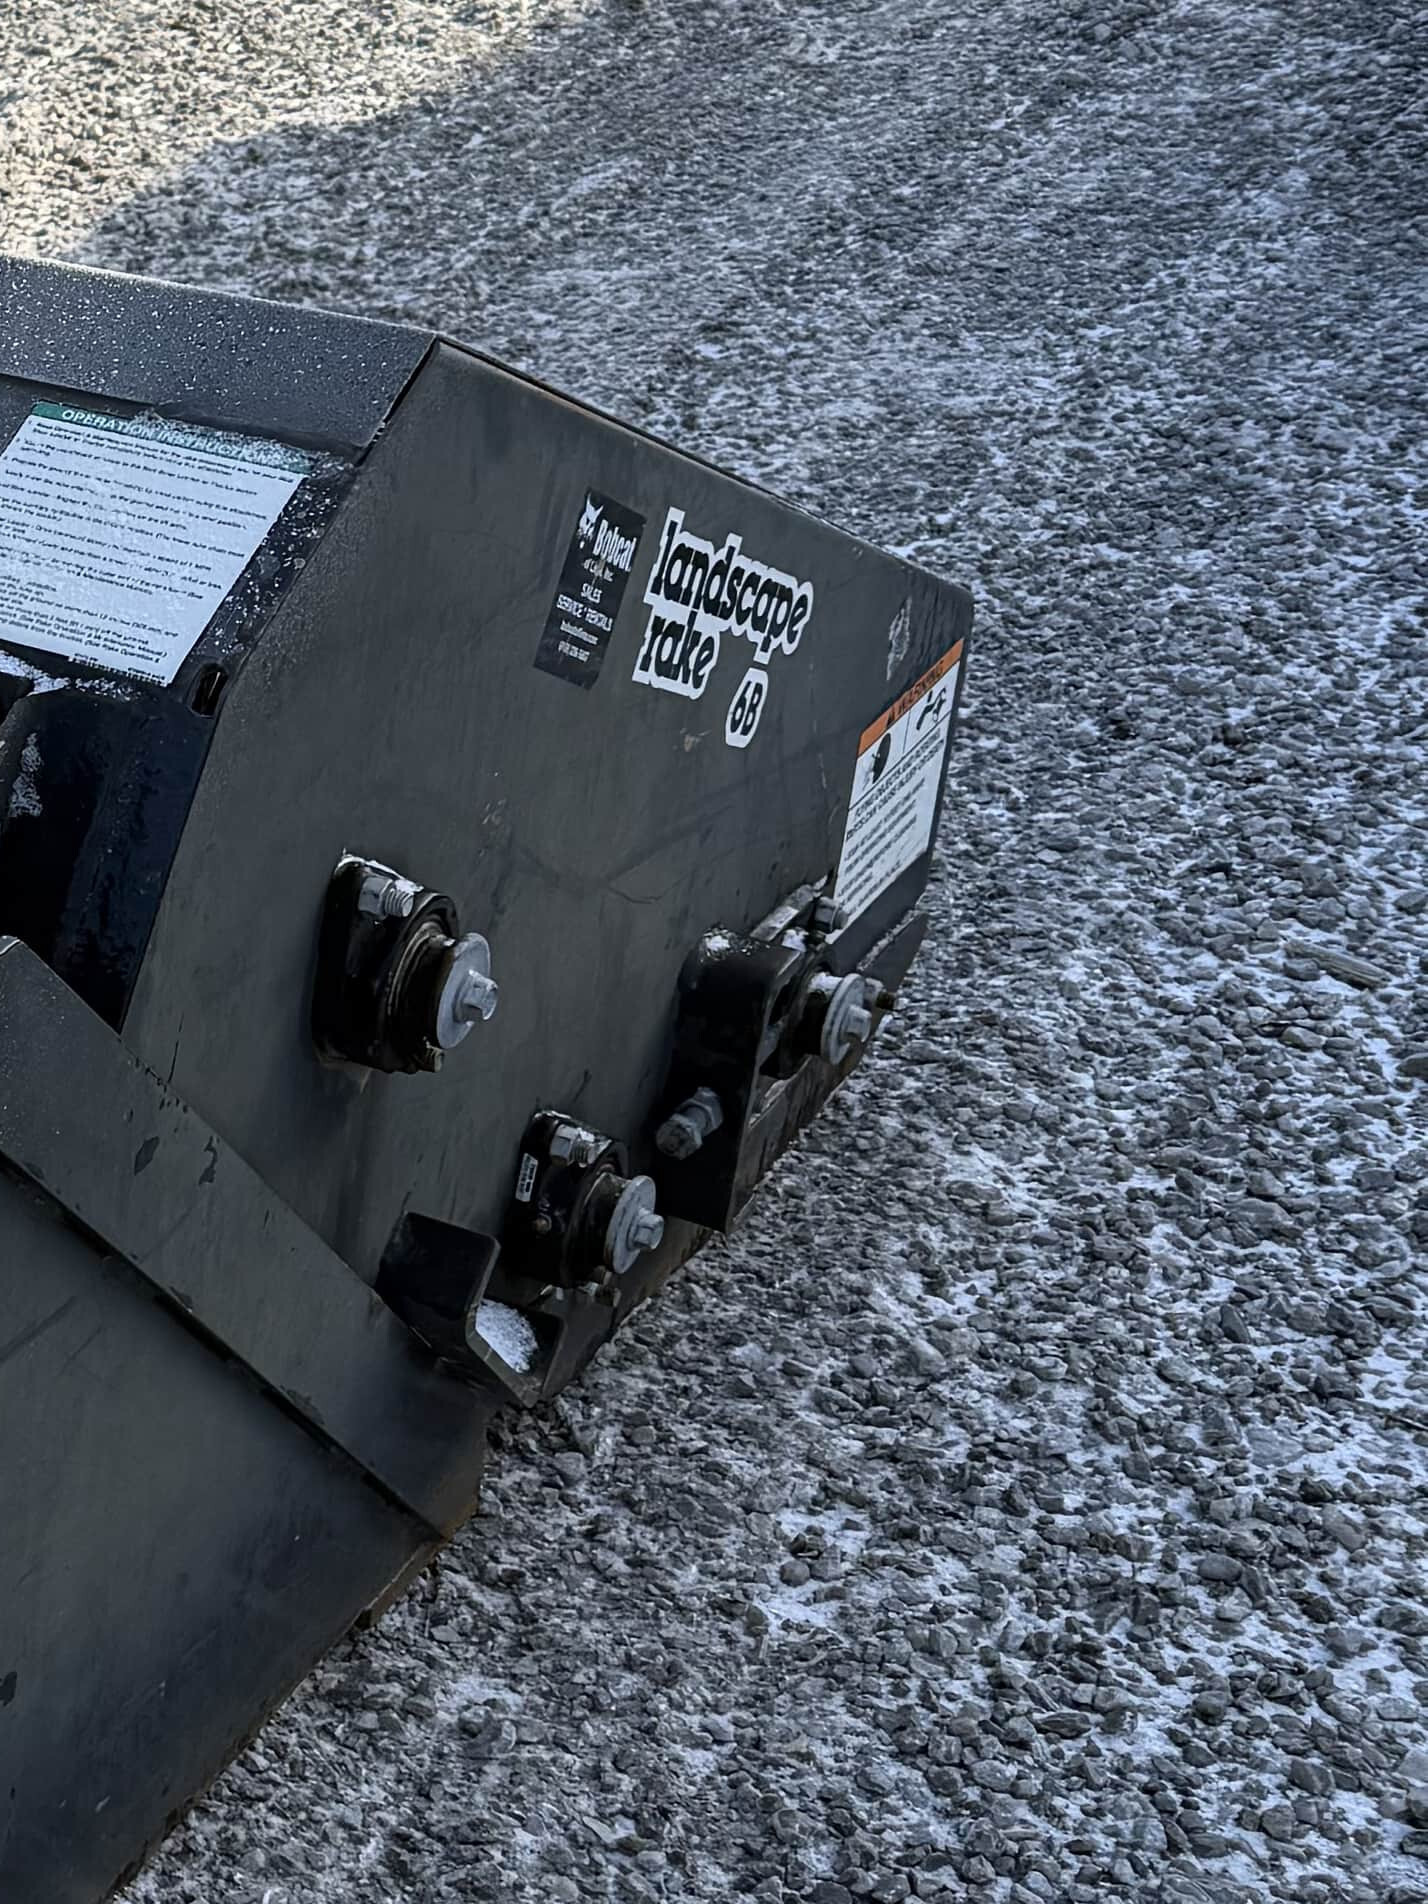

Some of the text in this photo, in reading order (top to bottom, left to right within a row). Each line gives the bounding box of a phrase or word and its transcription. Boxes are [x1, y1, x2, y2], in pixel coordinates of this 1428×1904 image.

[61, 409, 155, 437] OPERATION
[593, 519, 637, 571] Bobcat
[649, 517, 811, 655] landscape
[638, 610, 717, 691] rake
[730, 679, 764, 737] 6B
